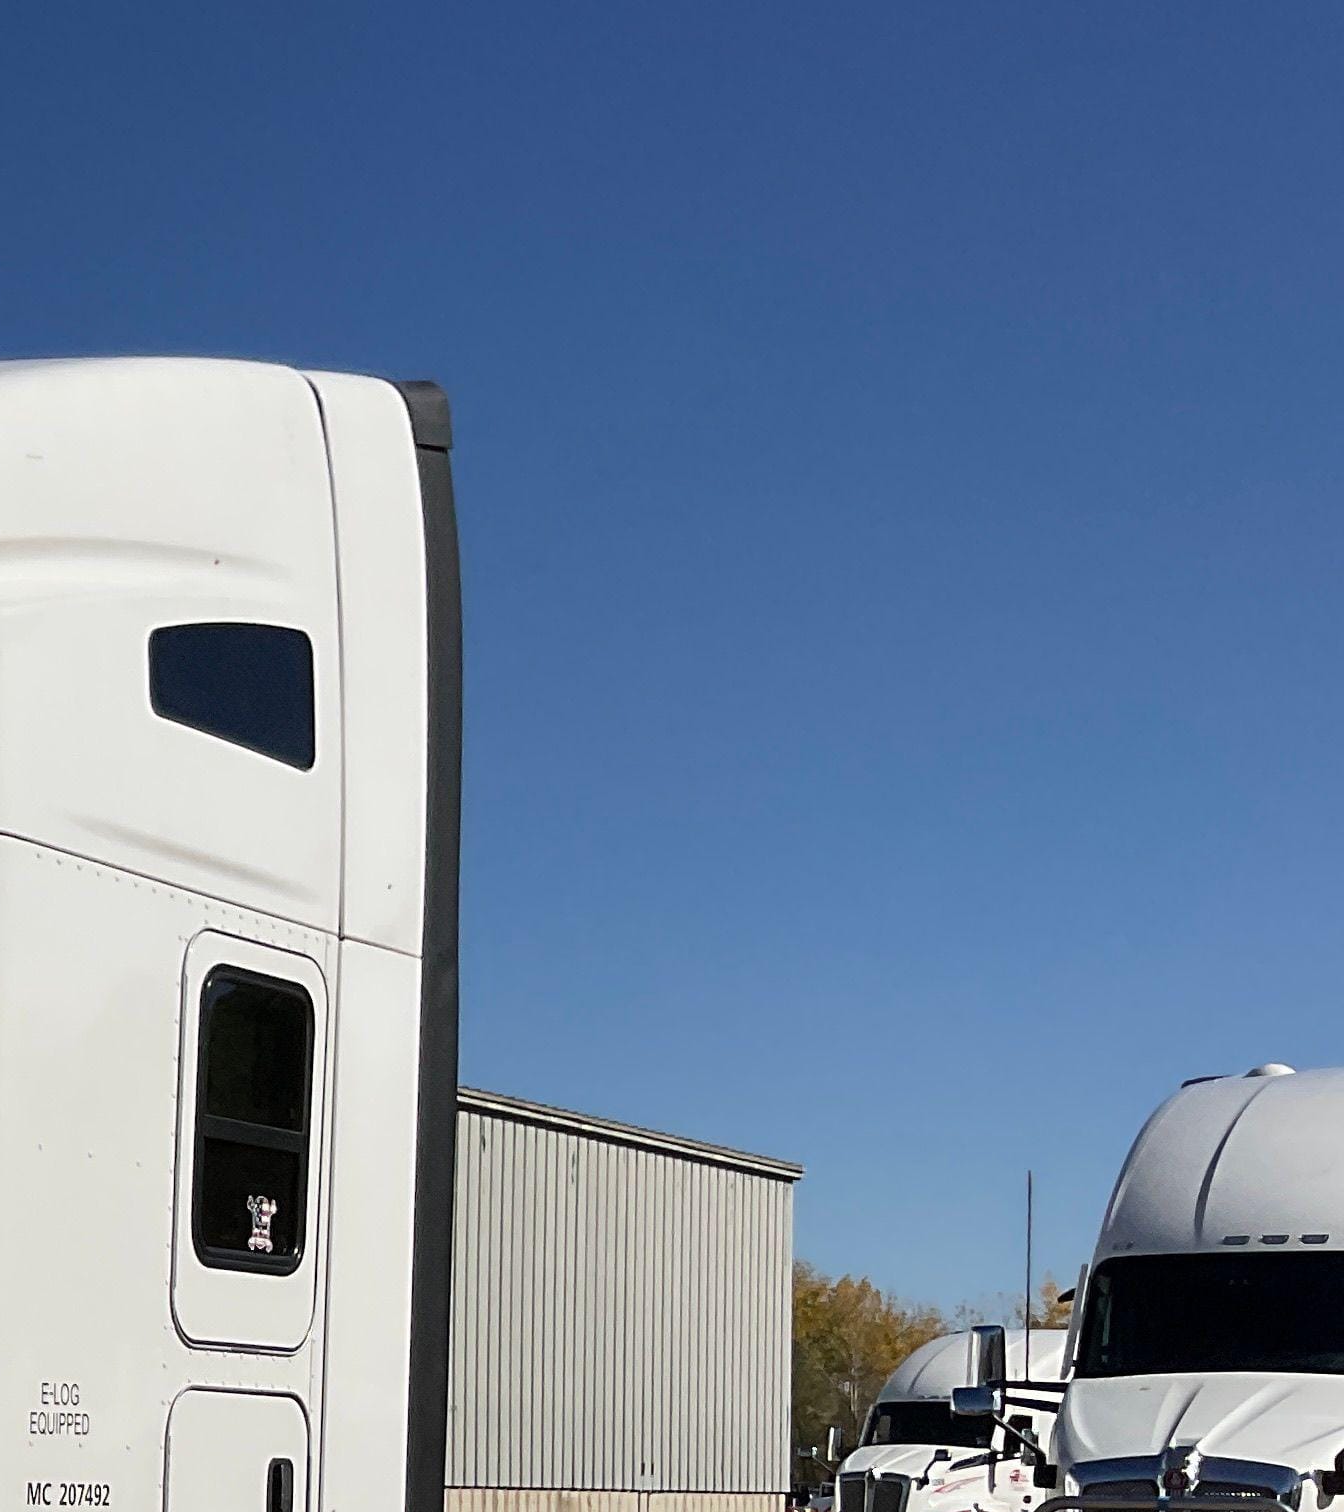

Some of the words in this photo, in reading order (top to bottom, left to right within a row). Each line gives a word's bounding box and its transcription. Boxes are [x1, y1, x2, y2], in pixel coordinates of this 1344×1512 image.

[41, 1382, 80, 1406] E-LOG
[29, 1411, 90, 1436] EQUIPPED
[26, 1482, 52, 1506] MC
[59, 1483, 110, 1506] 207492
